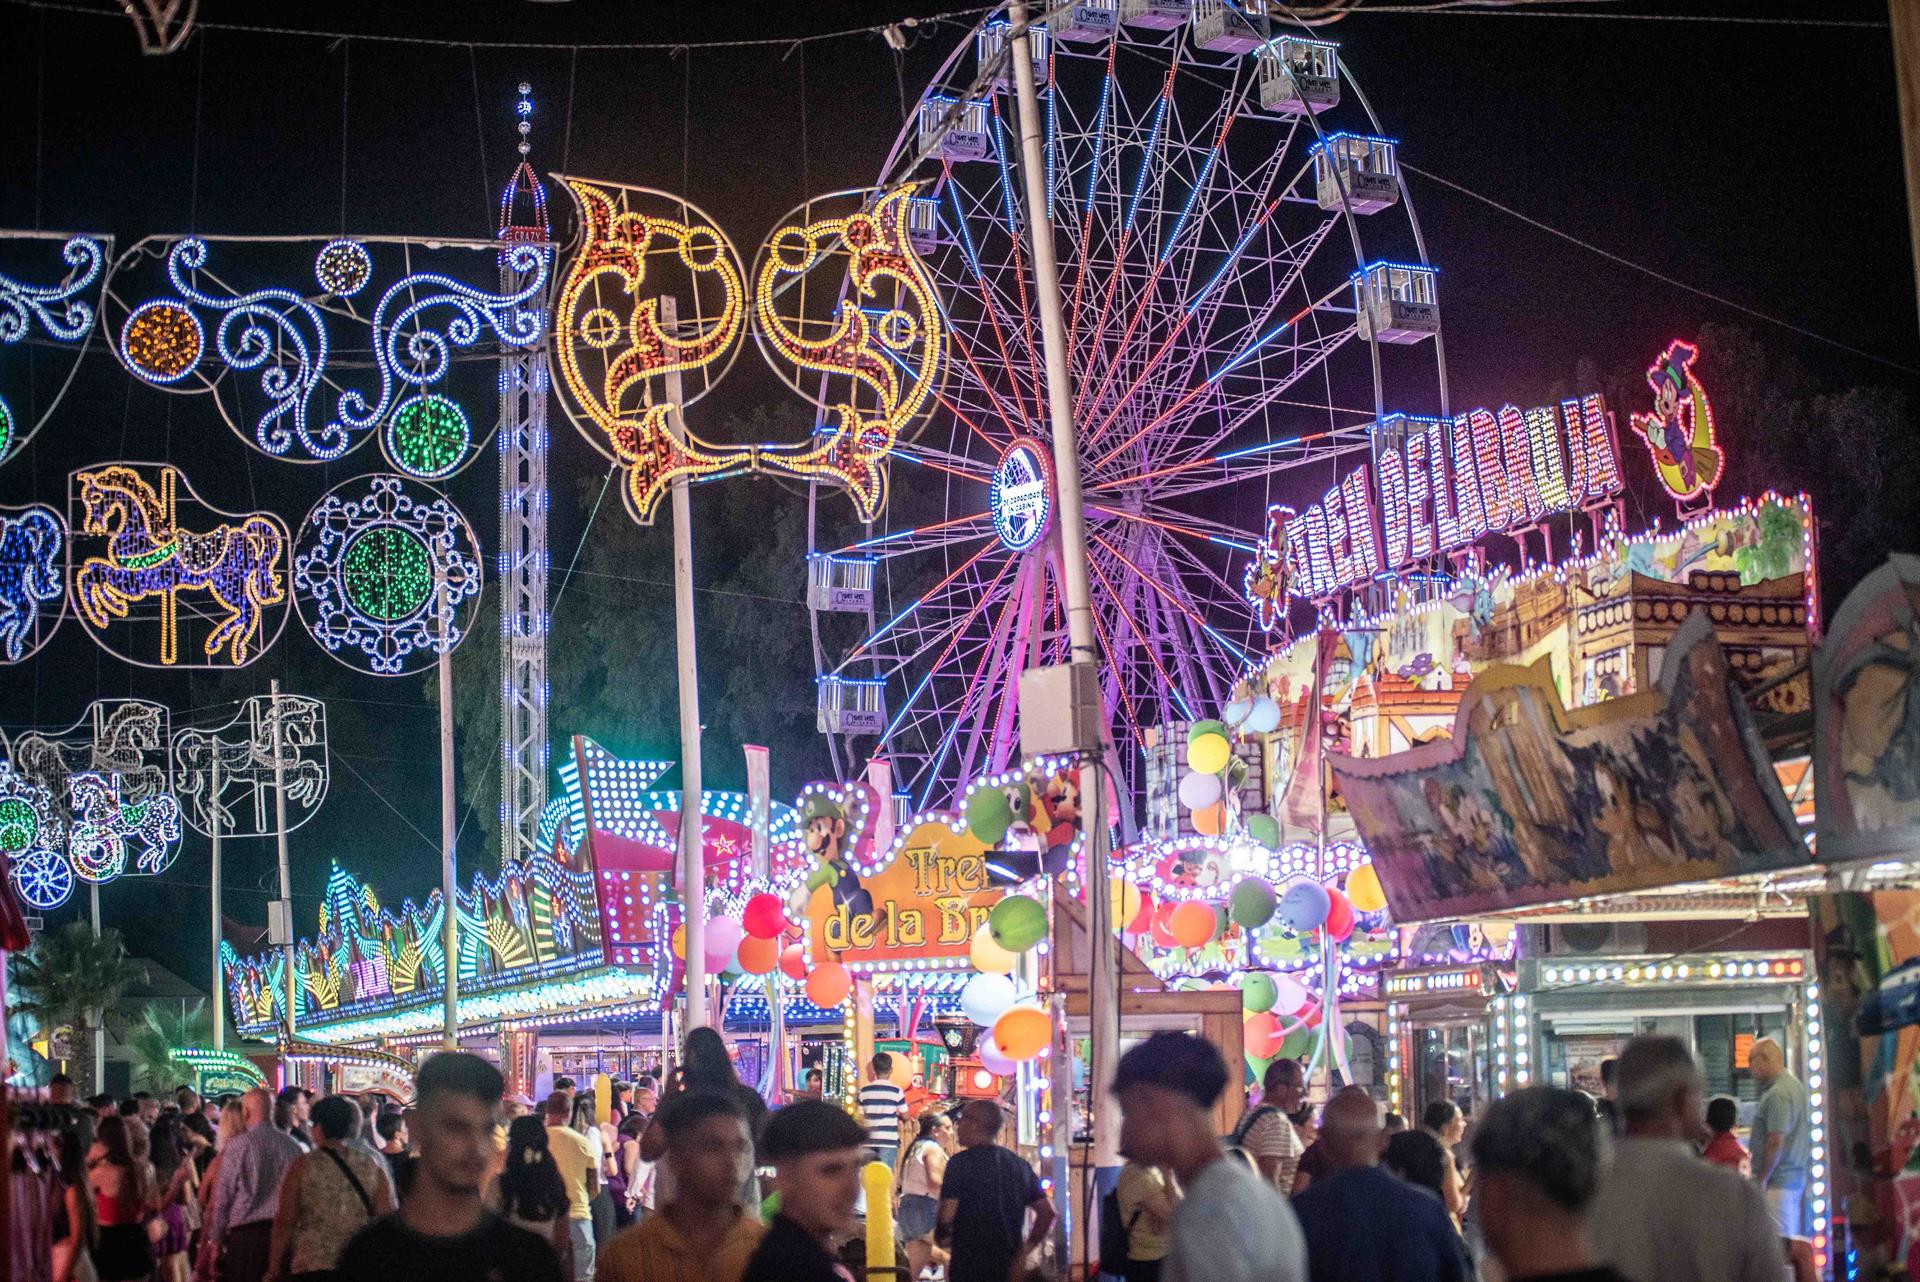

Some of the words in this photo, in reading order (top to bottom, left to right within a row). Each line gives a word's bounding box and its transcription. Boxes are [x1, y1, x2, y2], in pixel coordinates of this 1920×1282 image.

[514, 231, 541, 242] CRAZY
[1011, 492, 1040, 504] CAPACIDAD
[1285, 465, 1380, 598] TREN
[1378, 432, 1433, 569] DE
[1428, 413, 1487, 550] LA
[1470, 394, 1620, 531] BRUJA
[823, 904, 875, 951] de
[886, 899, 926, 948] la
